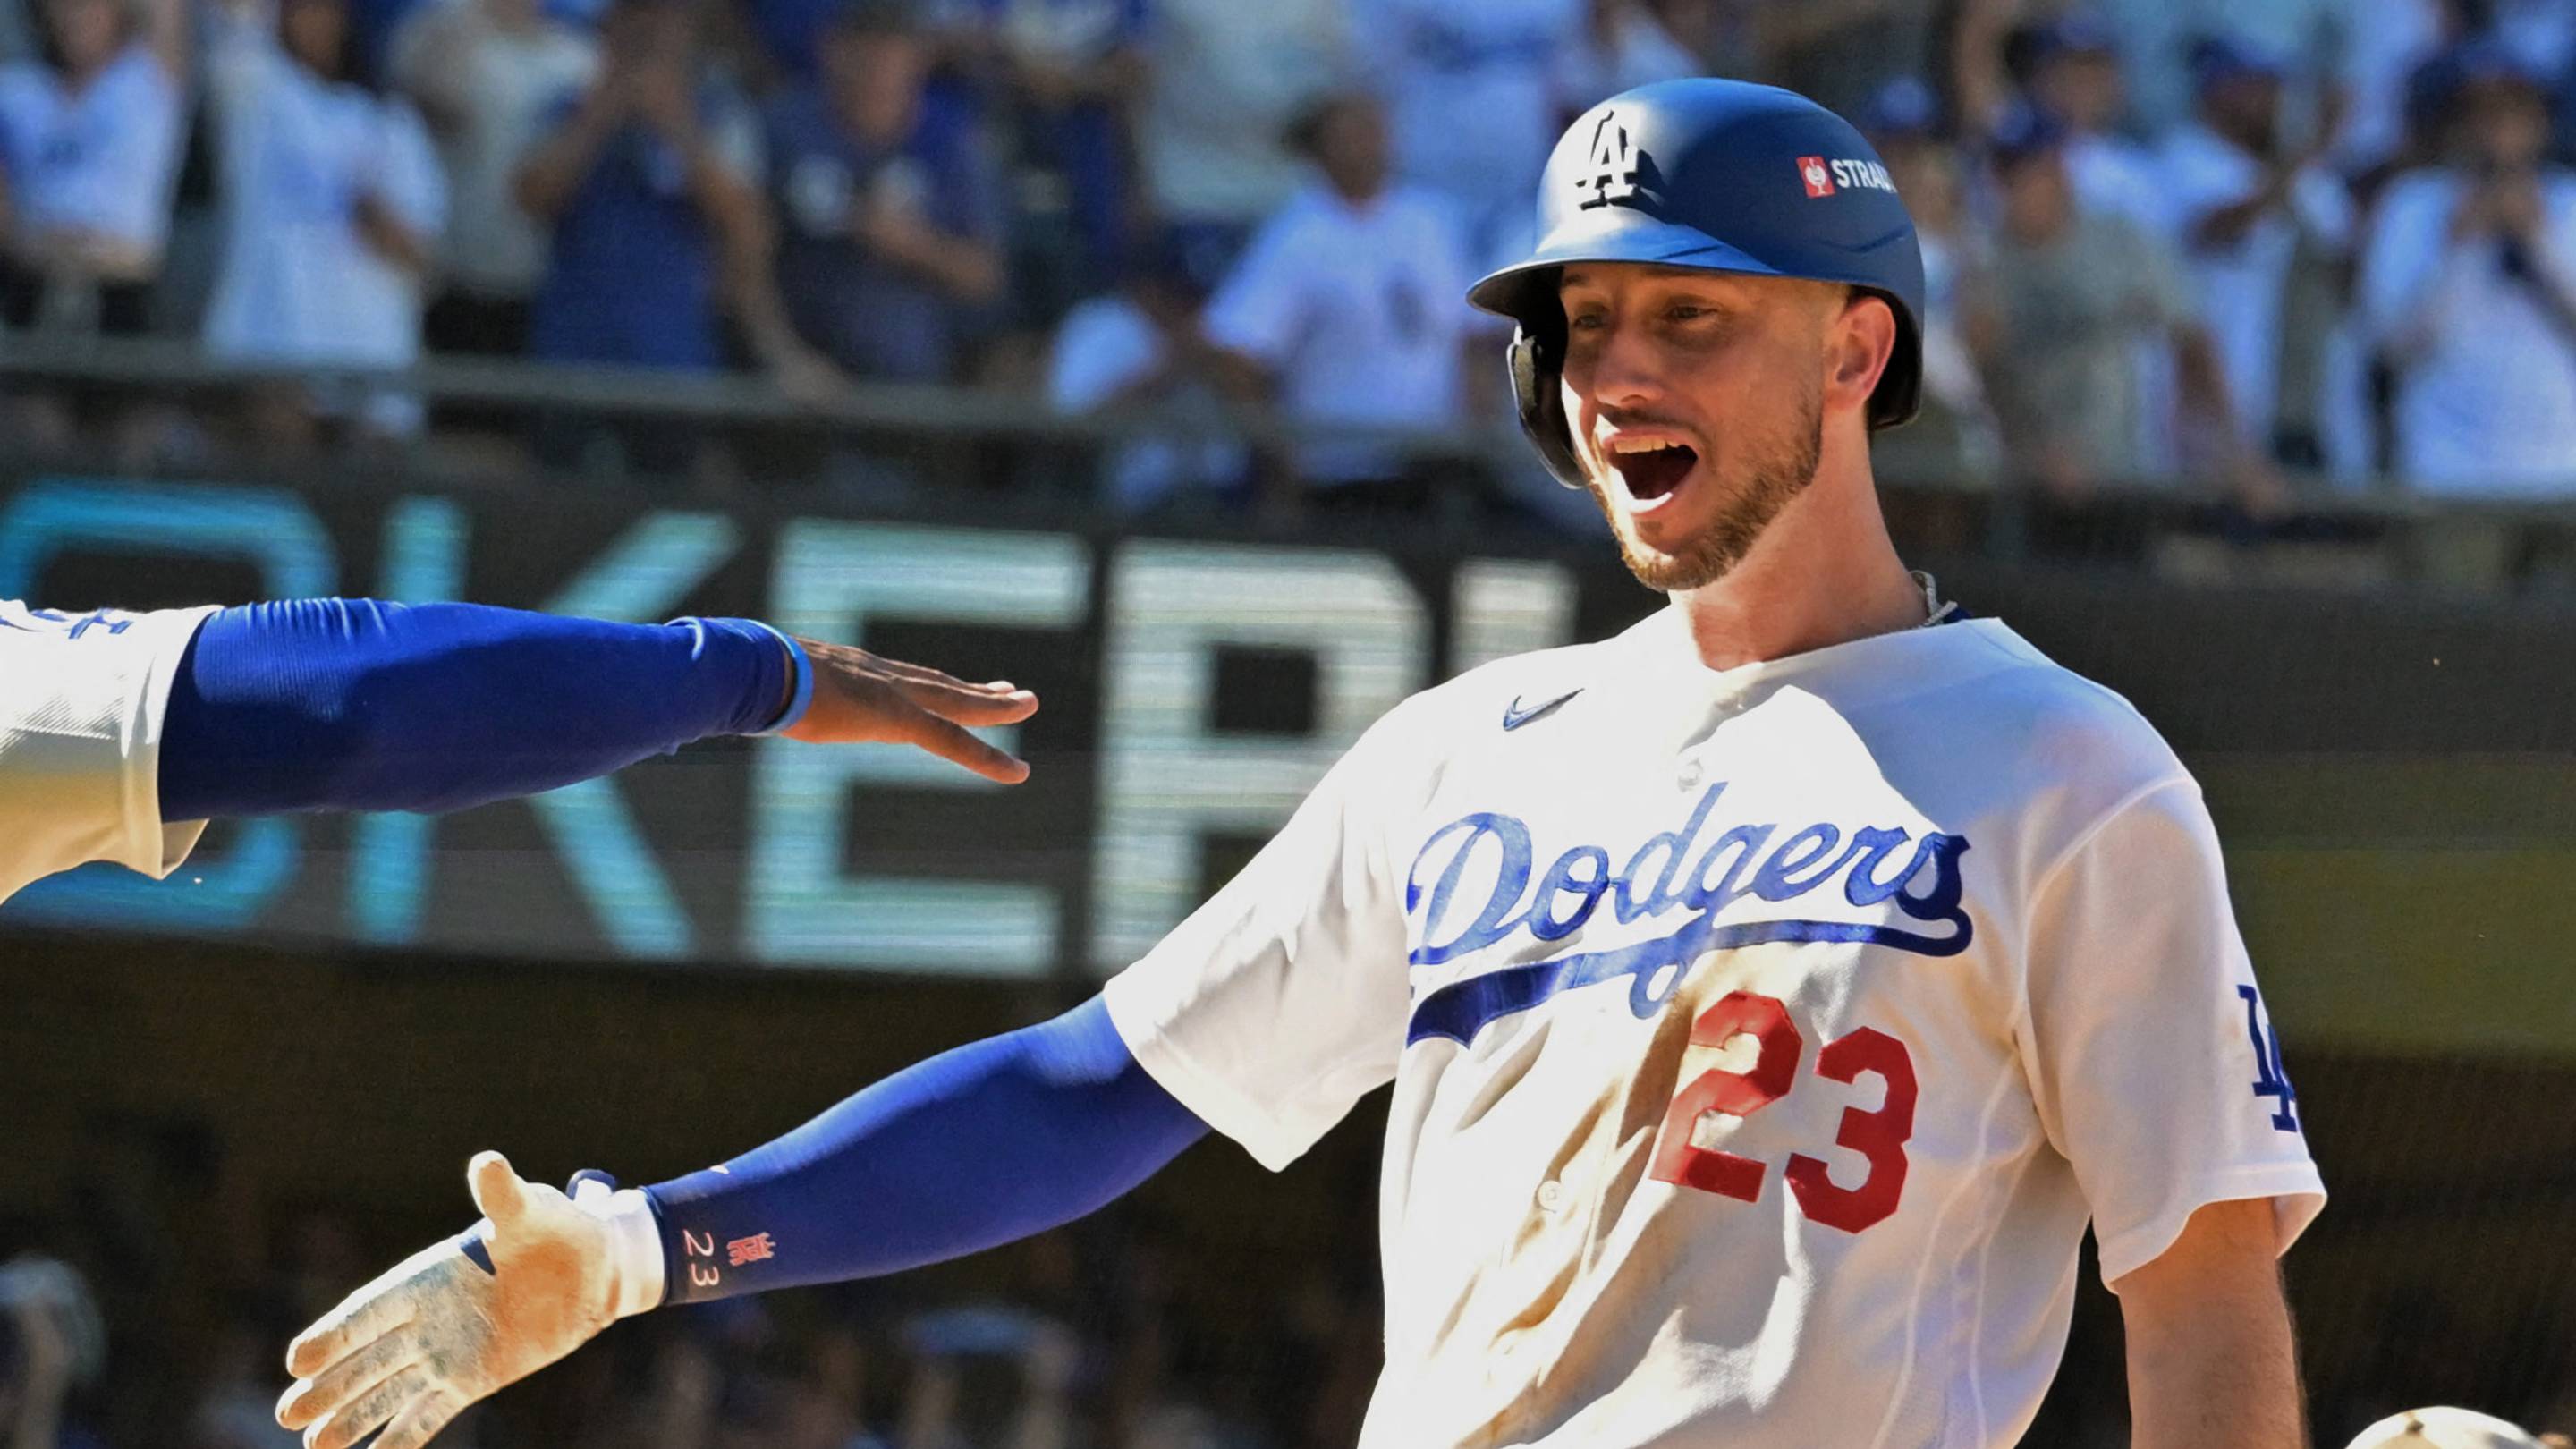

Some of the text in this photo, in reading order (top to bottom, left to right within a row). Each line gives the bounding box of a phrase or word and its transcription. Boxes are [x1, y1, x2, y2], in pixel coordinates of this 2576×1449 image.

[1574, 108, 1639, 211] LA
[1406, 782, 1973, 1021] Dodgers
[1649, 989, 1919, 1234] 23
[682, 1228, 720, 1287] 23
